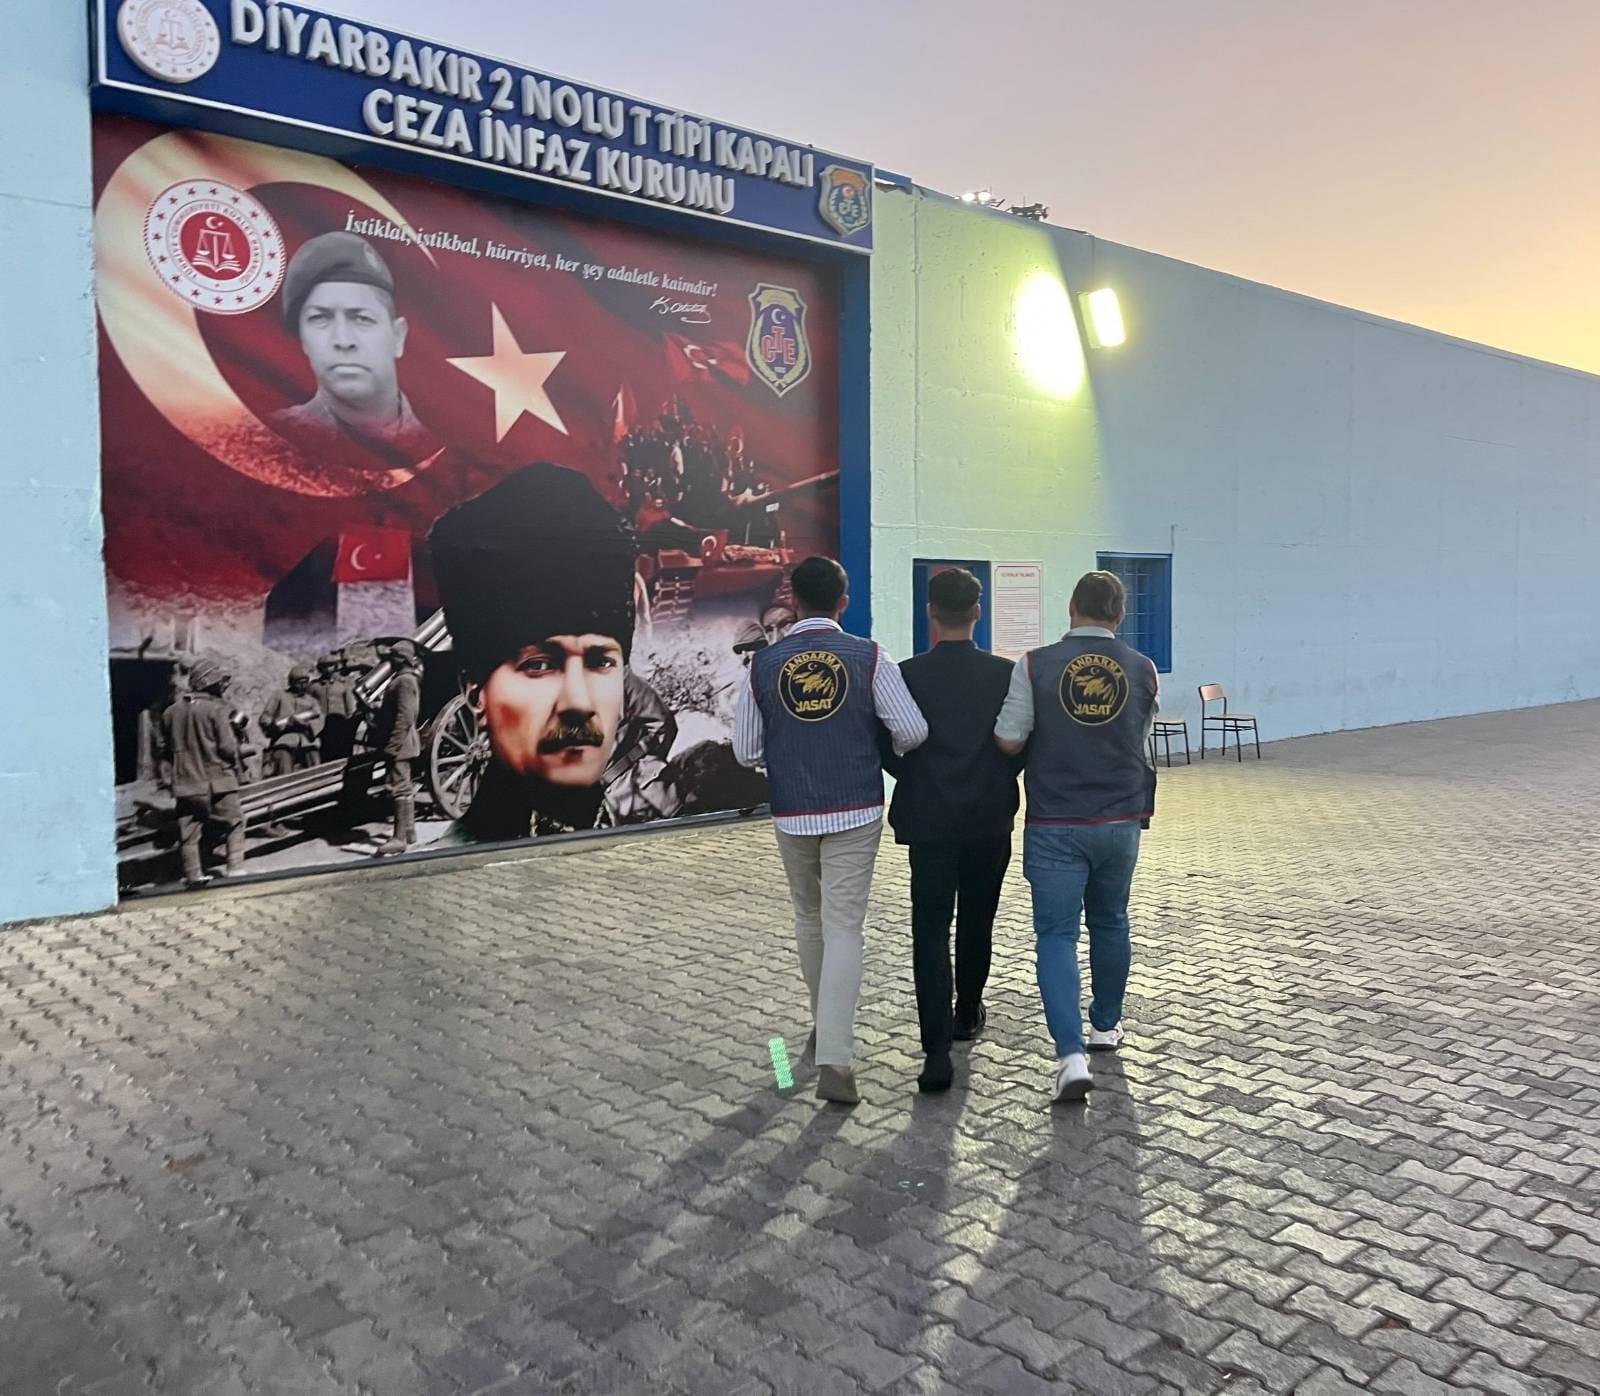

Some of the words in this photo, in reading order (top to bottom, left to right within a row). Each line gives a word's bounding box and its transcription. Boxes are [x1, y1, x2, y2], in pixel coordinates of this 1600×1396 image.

[231, 0, 483, 100] DİYARBAKIR
[488, 67, 514, 111] 2
[521, 74, 624, 139] NOLU
[629, 105, 652, 146] T
[654, 111, 712, 162] TİPİ
[715, 129, 814, 188] KAPALI
[362, 88, 474, 154] CEZA
[478, 108, 592, 182] İNFAZ
[596, 146, 735, 215] KURUMU
[416, 228, 481, 259] istikbal,
[485, 241, 551, 271] hürriyet,
[554, 253, 580, 273] her
[583, 263, 603, 281] şey
[607, 266, 659, 287] adaletle
[661, 274, 718, 297] kaimdir!
[784, 653, 842, 676] JANDARMA
[1067, 656, 1123, 679] JANDARMA
[795, 698, 832, 712] JASAT
[1074, 704, 1112, 716] JASAT
